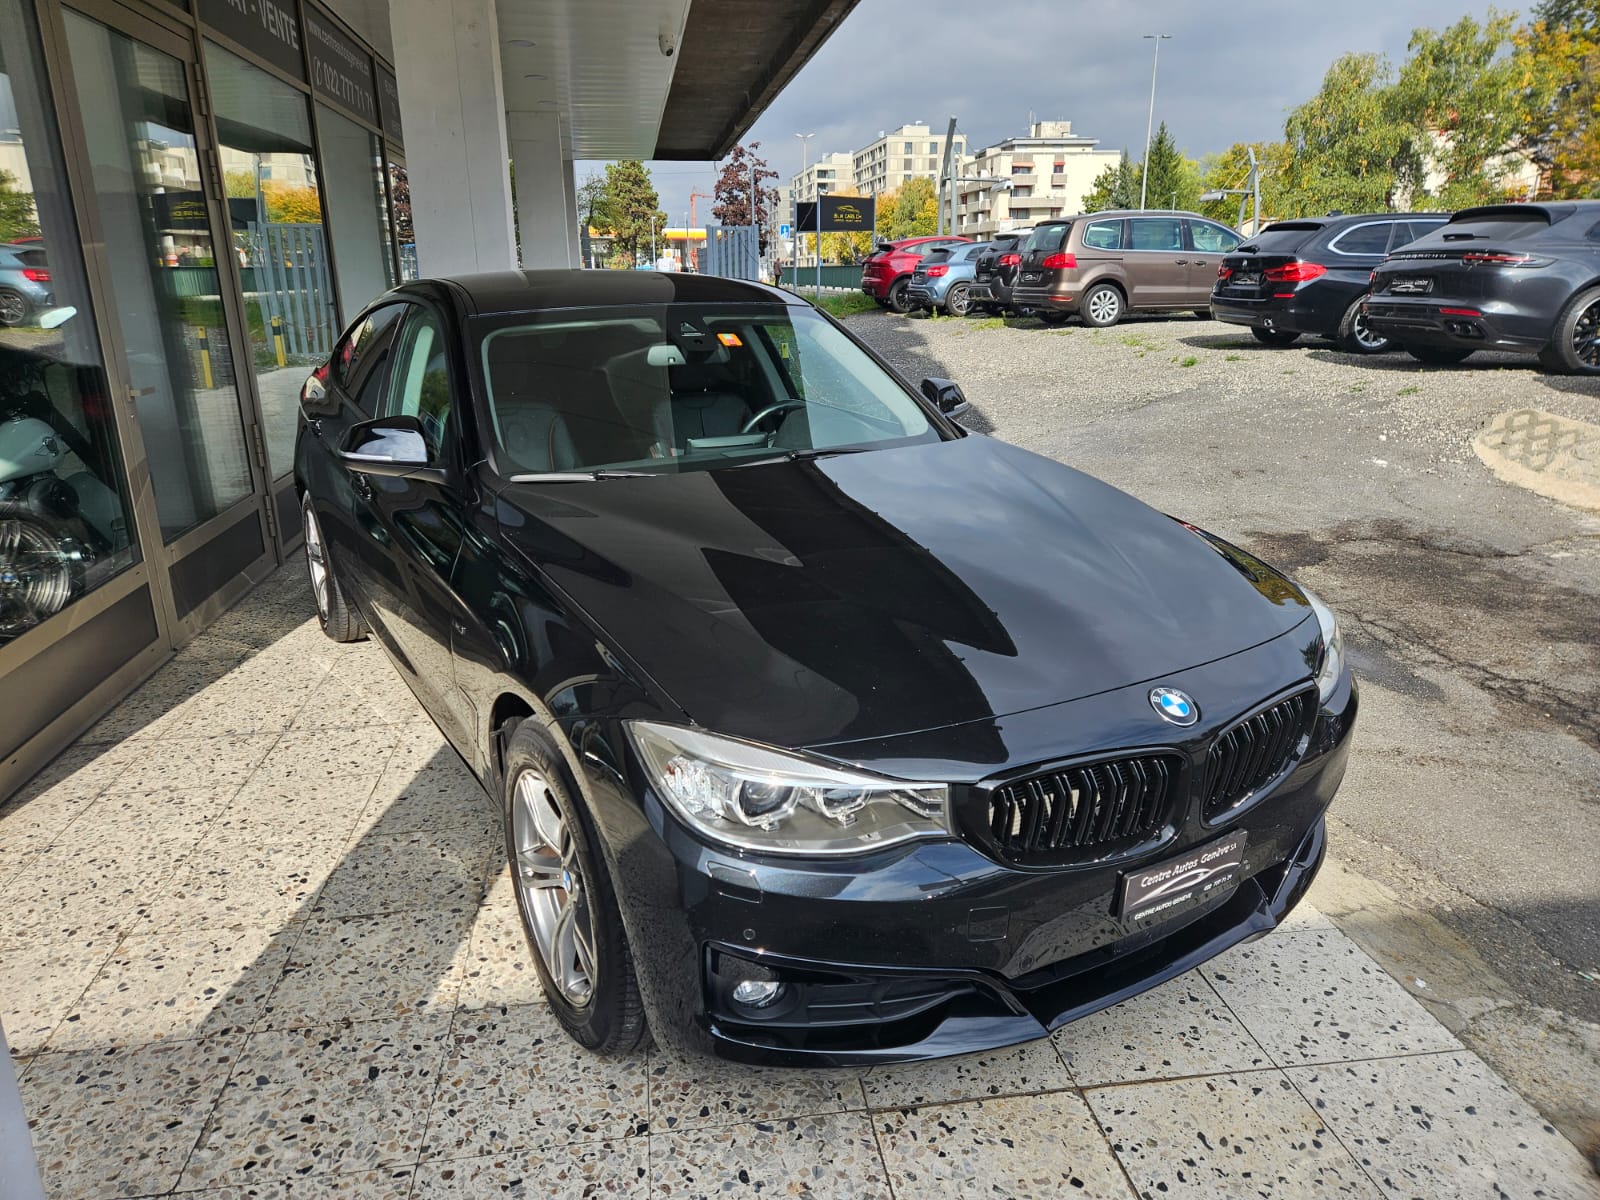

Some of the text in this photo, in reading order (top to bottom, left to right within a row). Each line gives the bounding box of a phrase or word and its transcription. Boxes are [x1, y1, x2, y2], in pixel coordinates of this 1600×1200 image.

[258, 0, 299, 50] VENTE
[323, 61, 340, 96] 022
[340, 74, 354, 105] 777
[1140, 869, 1172, 888] Centre
[1172, 858, 1199, 876] Autos
